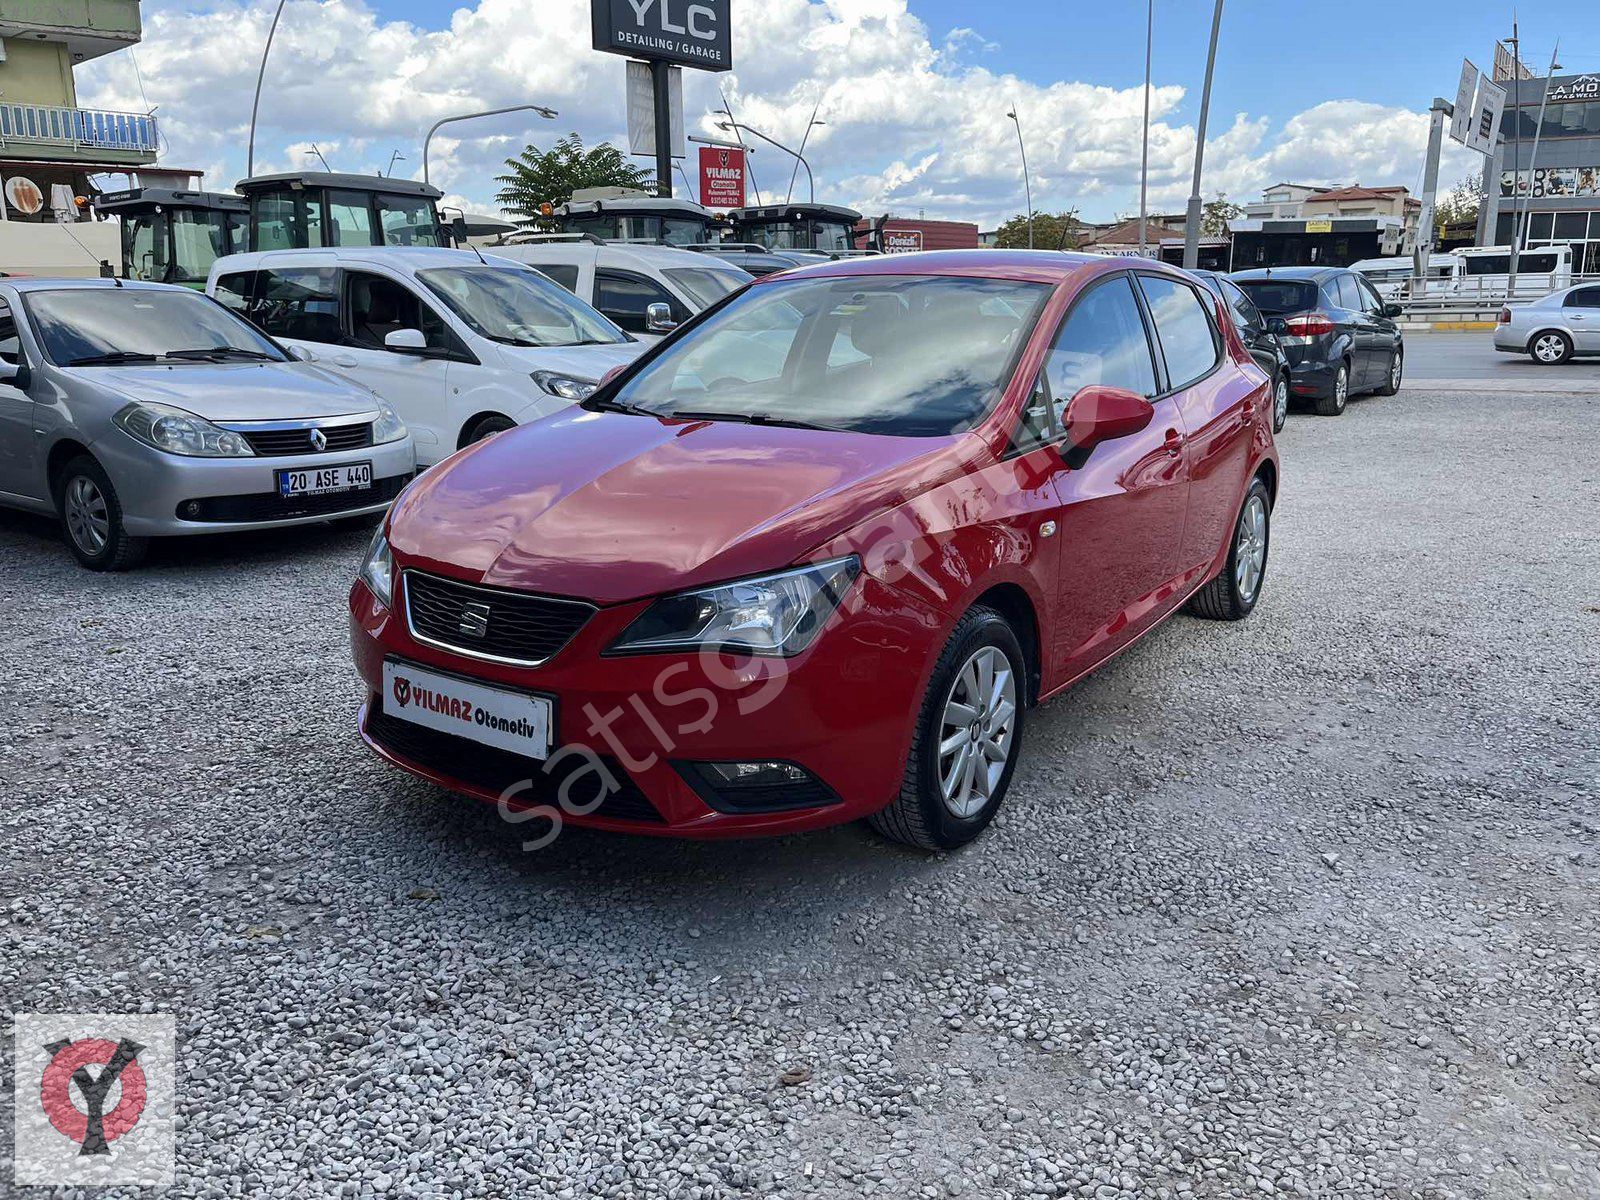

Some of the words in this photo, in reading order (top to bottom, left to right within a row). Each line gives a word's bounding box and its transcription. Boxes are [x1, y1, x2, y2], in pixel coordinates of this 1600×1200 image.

[627, 0, 717, 41] YLC
[618, 31, 674, 51] DETAILING
[682, 43, 721, 60] GARAGE
[706, 167, 741, 179] YILMAZ
[290, 473, 307, 491] 20
[316, 470, 339, 488] ASE
[347, 466, 369, 484] 440
[412, 686, 472, 722] YILMAZ
[474, 707, 535, 739] Otomotiv
